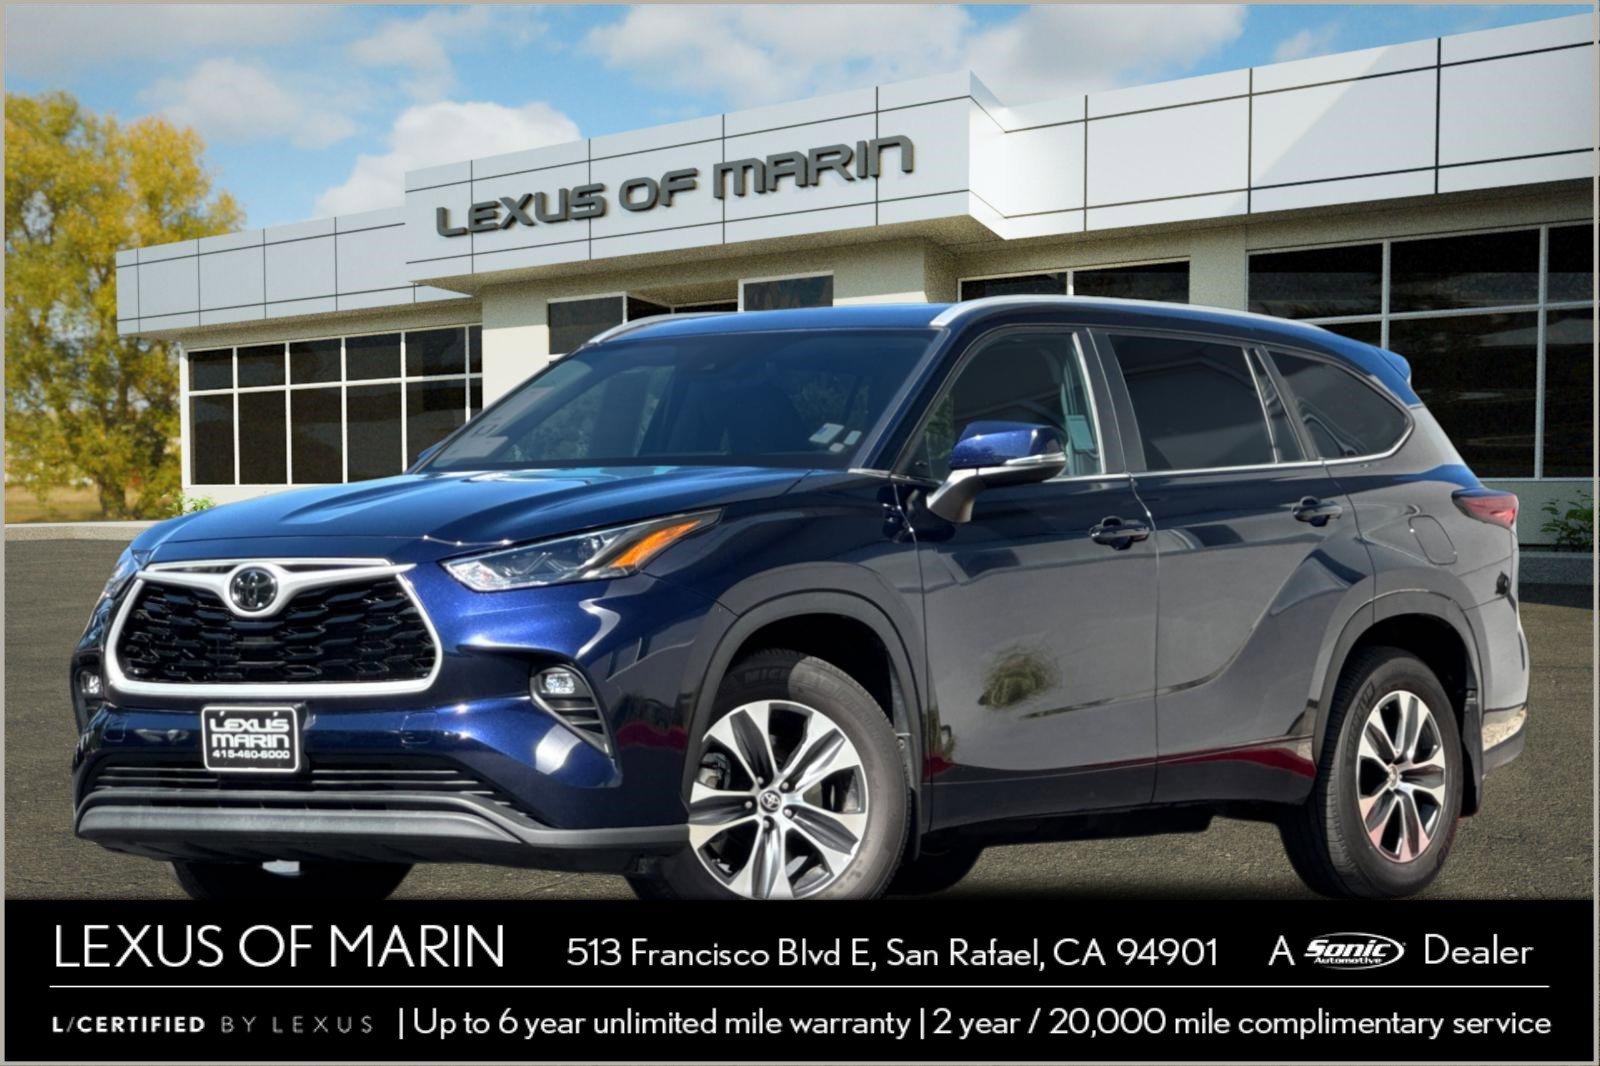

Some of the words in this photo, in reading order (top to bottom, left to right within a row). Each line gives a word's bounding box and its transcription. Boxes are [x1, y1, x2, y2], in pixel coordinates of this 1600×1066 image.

[436, 183, 606, 237] LEXUS
[618, 167, 699, 211] OF
[713, 135, 914, 200] MARIN
[209, 718, 290, 733] LEXUS
[211, 733, 290, 749] MARIN
